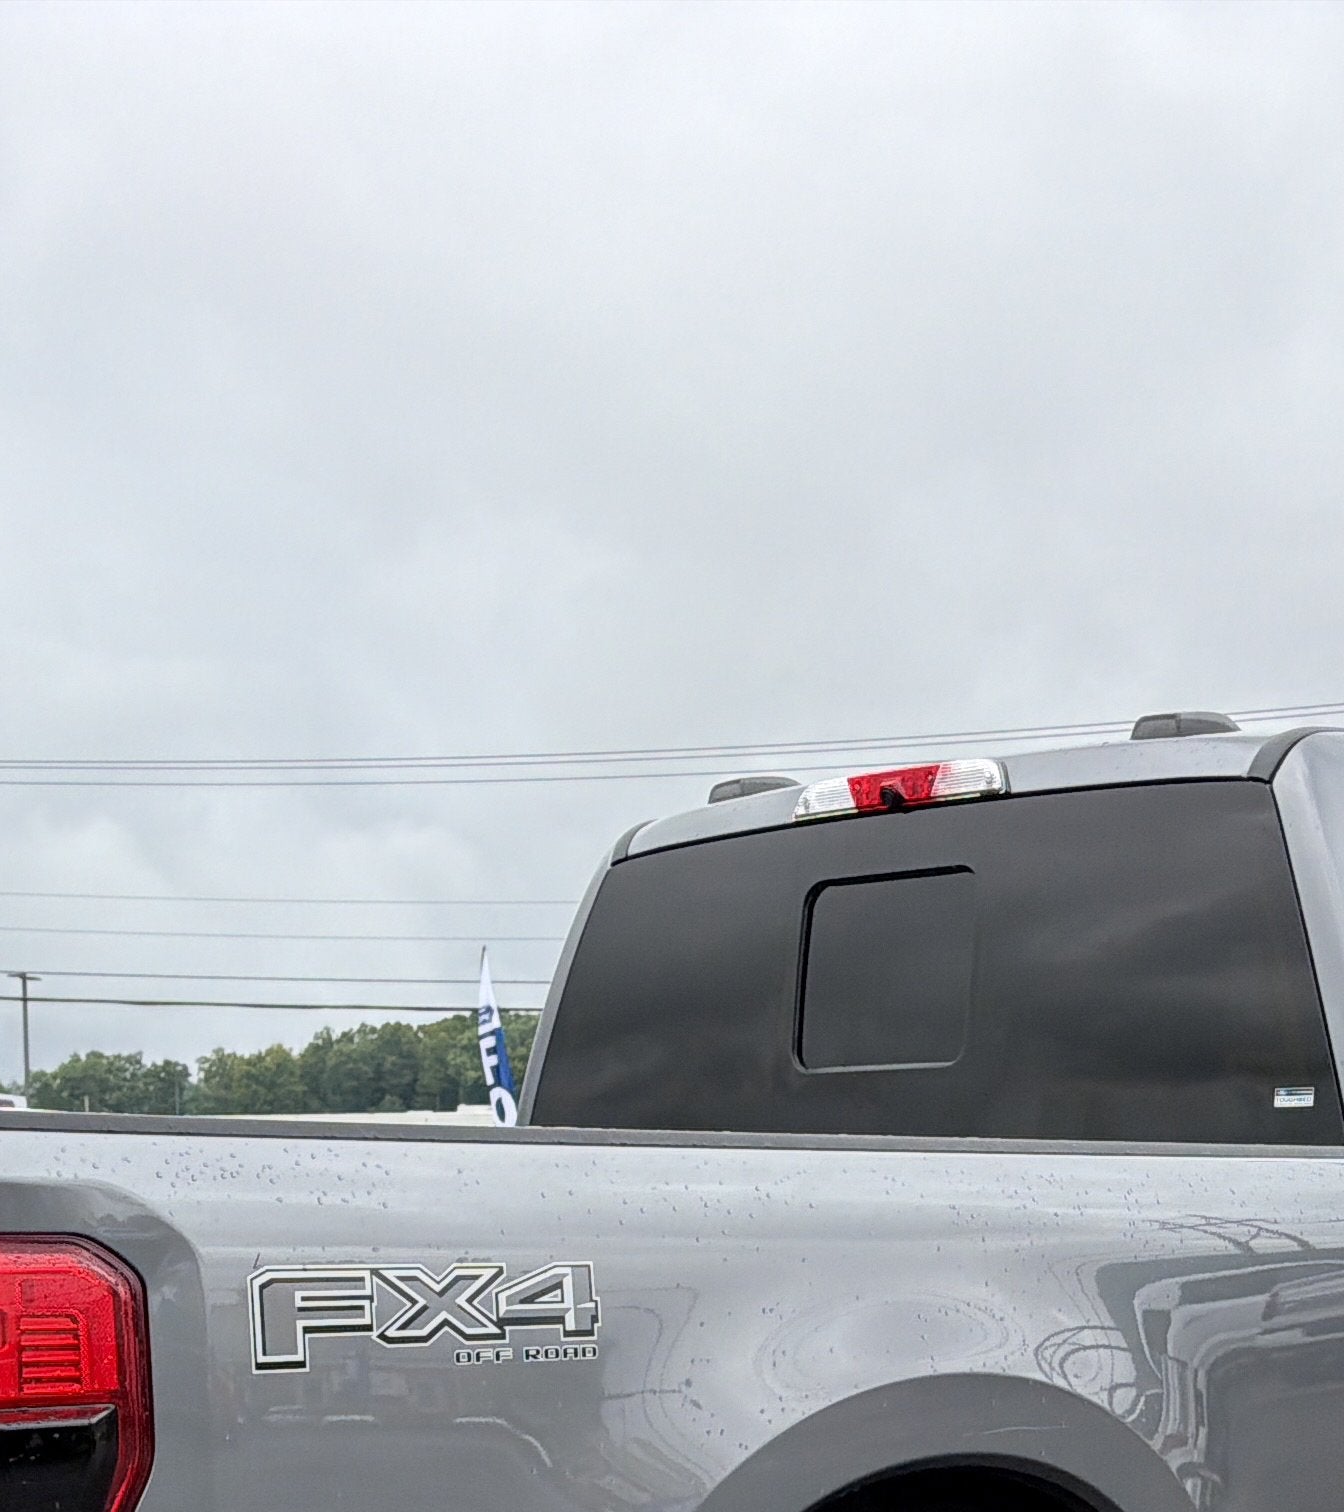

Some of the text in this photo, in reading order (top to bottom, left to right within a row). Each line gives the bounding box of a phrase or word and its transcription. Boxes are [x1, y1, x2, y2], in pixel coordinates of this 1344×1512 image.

[247, 1261, 602, 1374] FX4
[454, 1344, 599, 1366] OFF ROAD
